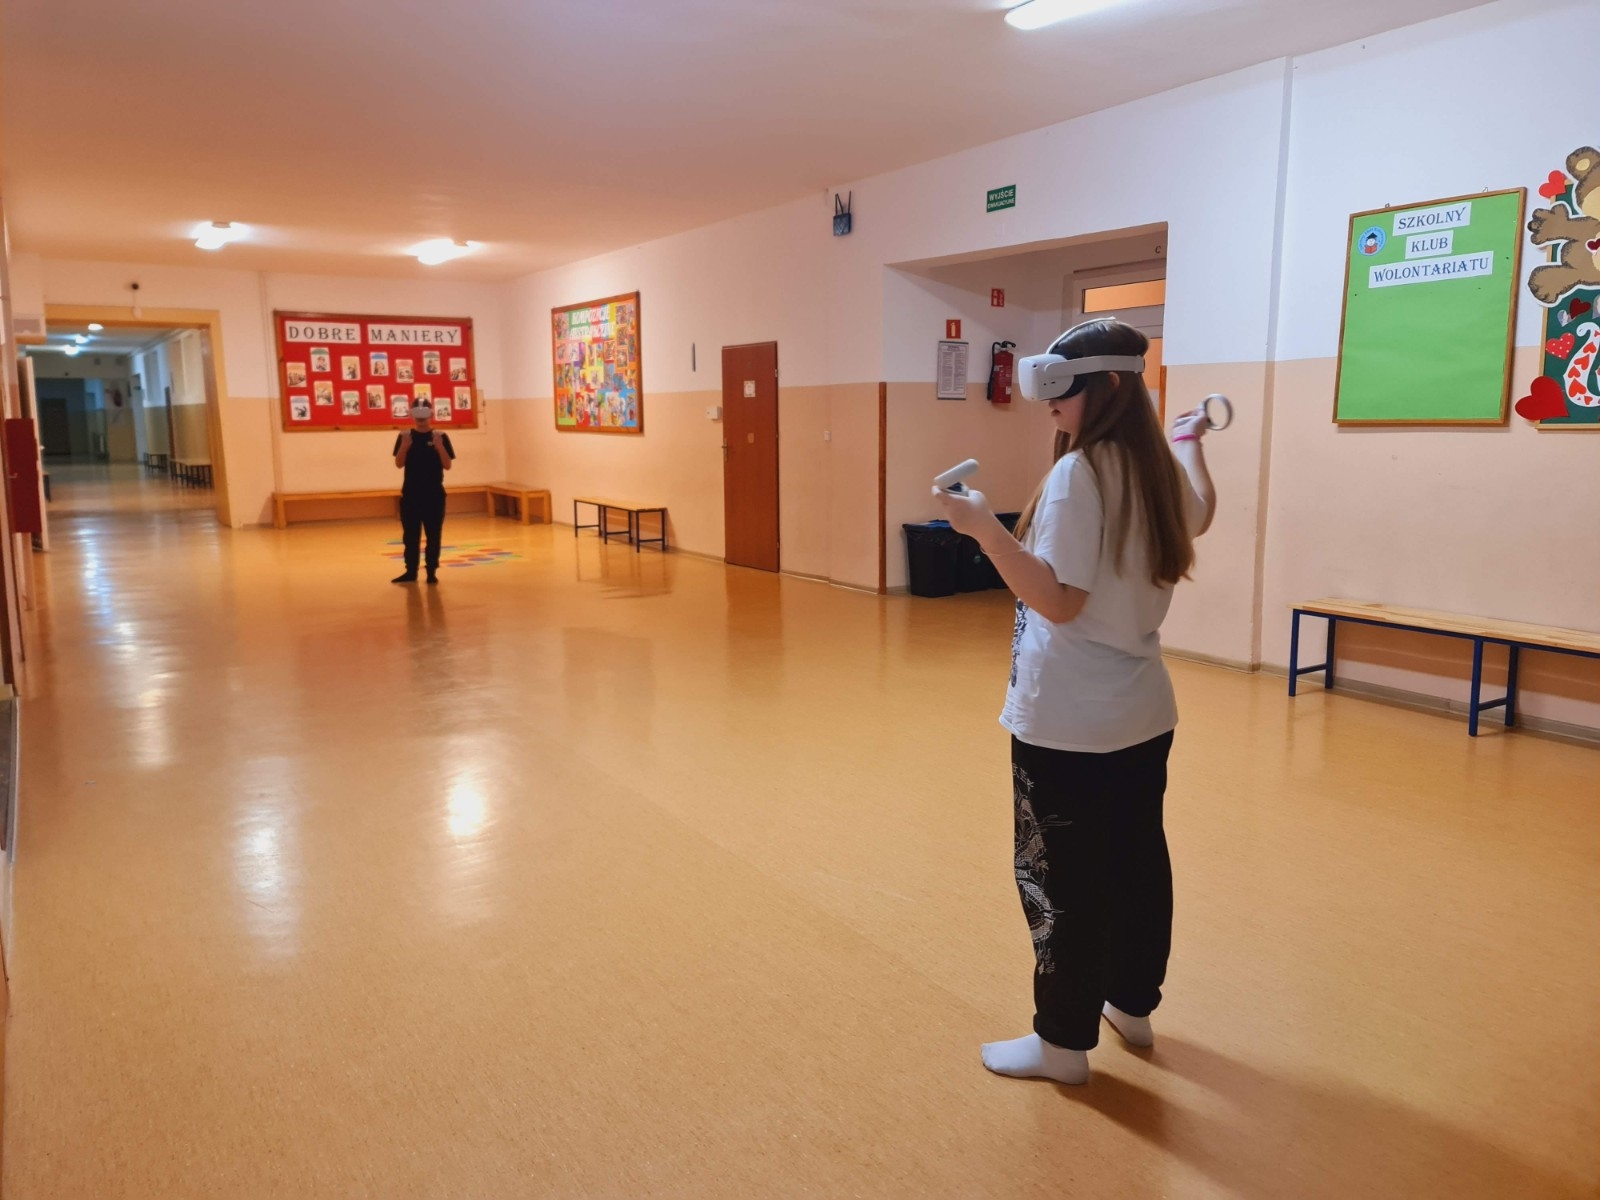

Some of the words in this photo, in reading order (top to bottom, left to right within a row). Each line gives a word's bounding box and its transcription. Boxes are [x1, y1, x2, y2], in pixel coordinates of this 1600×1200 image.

[989, 189, 1014, 202] WYJŚCIE
[1398, 206, 1466, 230] SZKOLNY
[1411, 237, 1448, 253] KLUB
[1374, 257, 1489, 282] WOLONTARIATU
[289, 326, 356, 341] DOBRE
[371, 328, 458, 343] MANIERY
